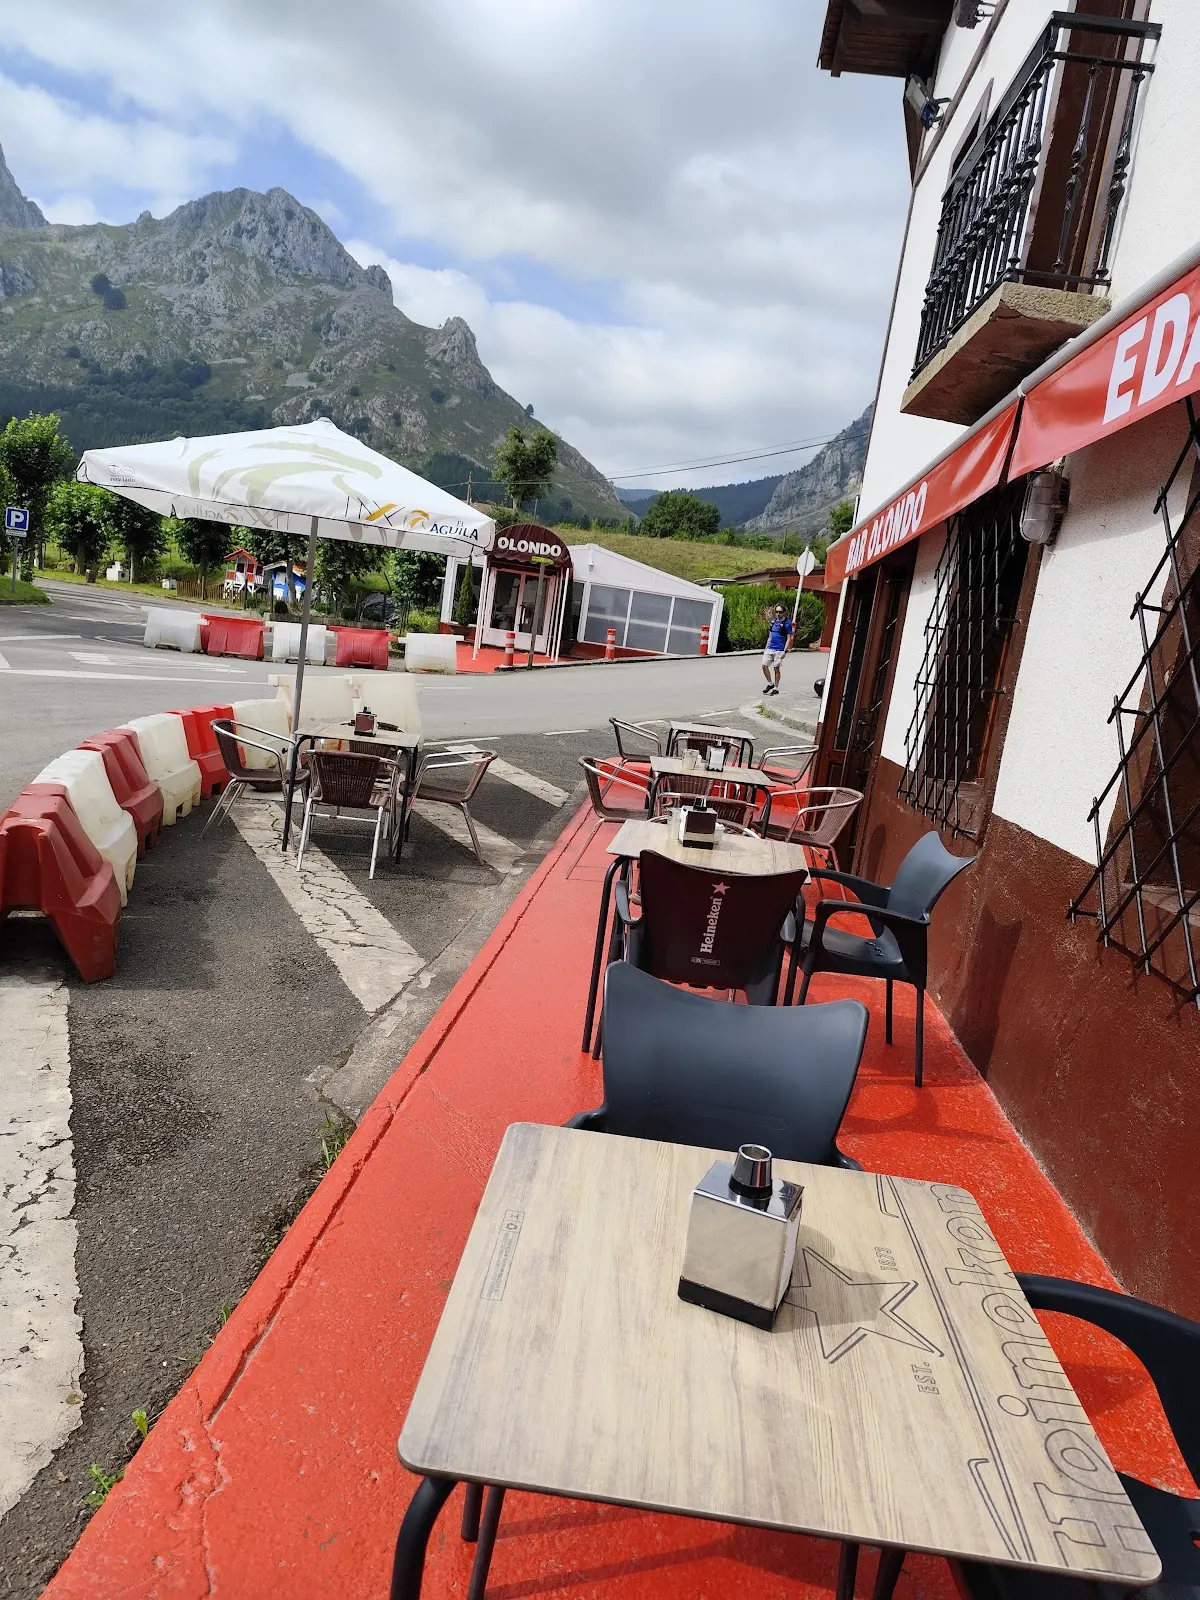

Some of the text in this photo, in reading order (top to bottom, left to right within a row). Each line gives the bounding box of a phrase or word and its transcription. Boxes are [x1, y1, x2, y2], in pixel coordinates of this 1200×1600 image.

[10, 511, 25, 527] P
[845, 481, 928, 574] BAR OLONDO
[497, 536, 562, 557] OLONDO
[700, 897, 723, 954] Heineken
[911, 1361, 940, 1395] EST.
